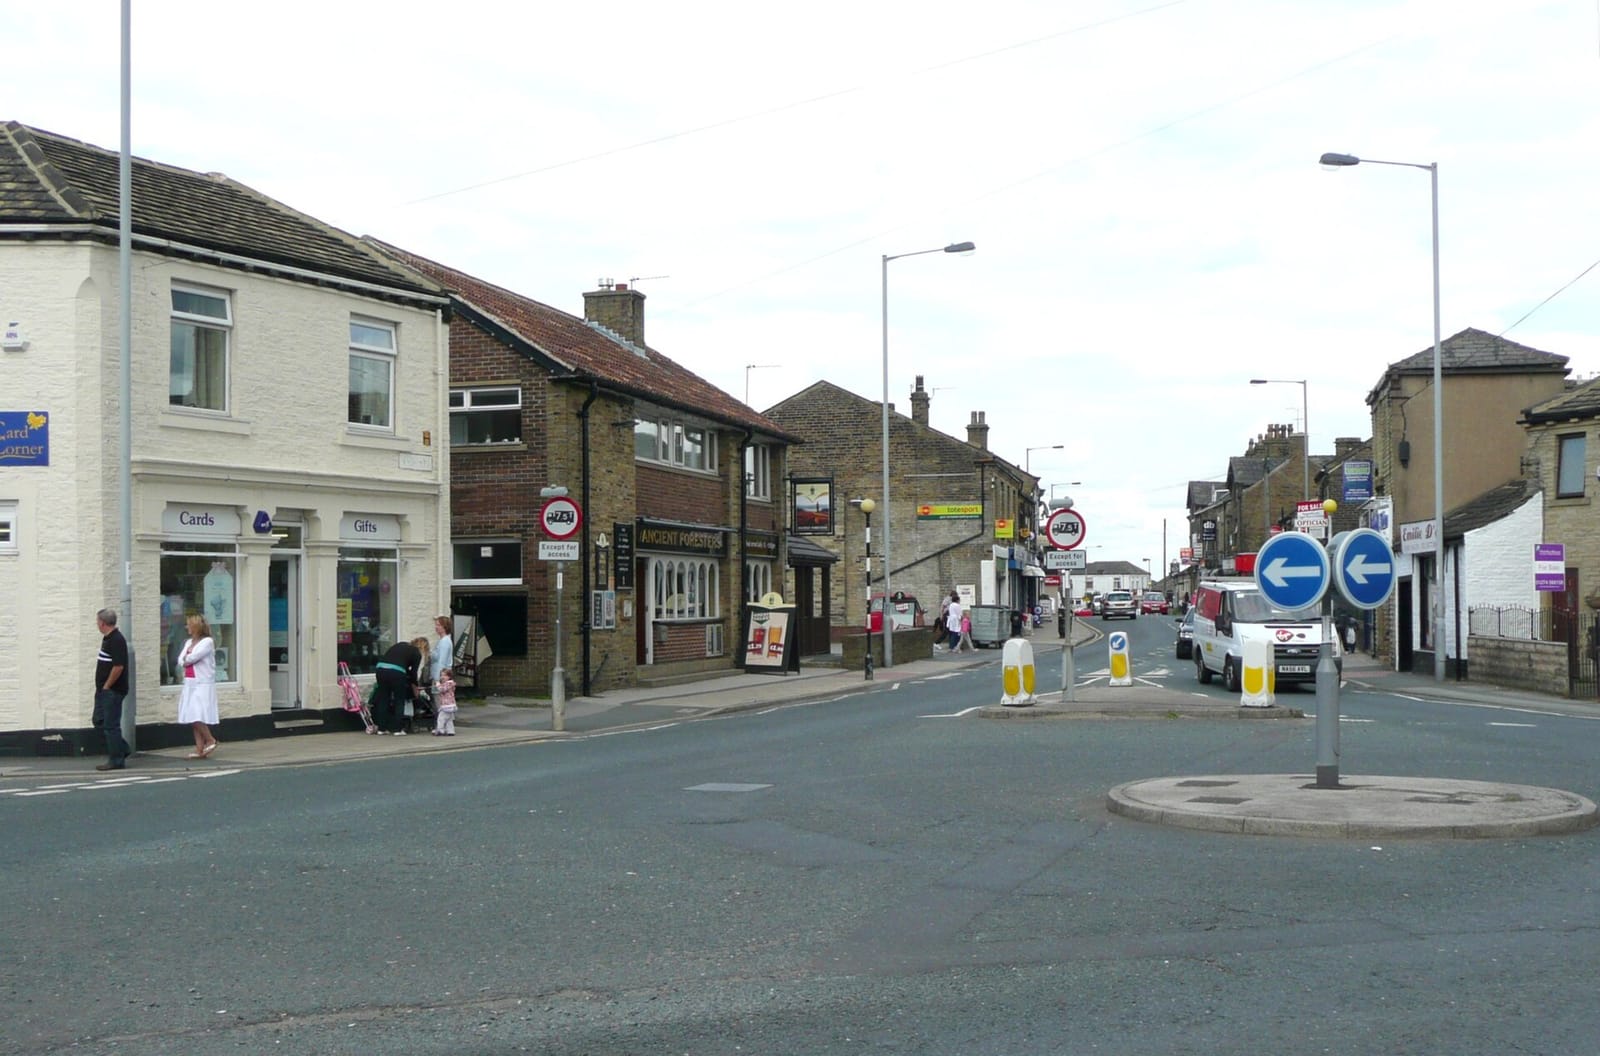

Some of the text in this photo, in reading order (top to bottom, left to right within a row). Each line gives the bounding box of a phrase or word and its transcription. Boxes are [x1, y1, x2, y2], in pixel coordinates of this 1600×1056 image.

[0, 445, 43, 455] orner
[946, 505, 979, 514] totesport
[1297, 504, 1309, 512] FOR
[180, 511, 215, 527] Cards
[1296, 519, 1327, 527] OPTICIAN
[354, 519, 377, 533] Gifts
[641, 528, 723, 549] ANCIENT FORESTERS
[541, 543, 577, 551] Except for
[1048, 553, 1072, 561] Except
